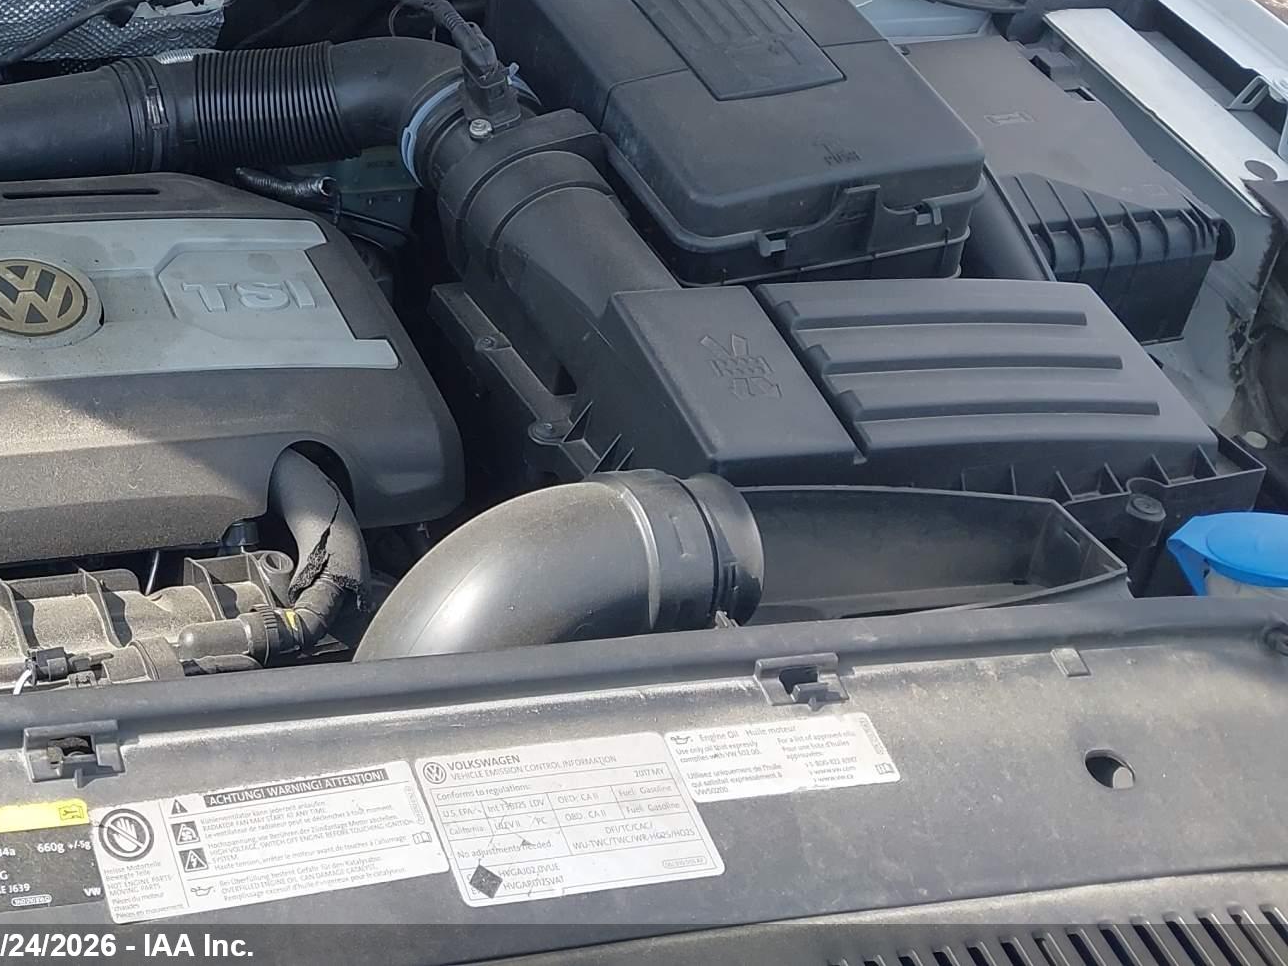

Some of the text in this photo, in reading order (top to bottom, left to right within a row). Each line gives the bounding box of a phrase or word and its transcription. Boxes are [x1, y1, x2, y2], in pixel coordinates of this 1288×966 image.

[182, 280, 317, 313] TSI
[699, 732, 727, 742] Engine
[726, 730, 740, 738] Oil
[447, 755, 520, 770] VOLKSWAGEN
[451, 756, 616, 779] VEHICLE EMISSION CONTROL INFORMATION
[210, 771, 384, 805] ACHTUNG! WARNING! ATTENTION!
[436, 790, 474, 800] Conforms
[475, 788, 484, 796] to
[639, 784, 672, 794] Gasoline
[529, 799, 546, 807] LDV
[580, 793, 592, 801] CA
[647, 801, 680, 811] Gasoline
[37, 842, 64, 855] 660g
[470, 845, 521, 858] adjustments
[84, 888, 101, 896] VW
